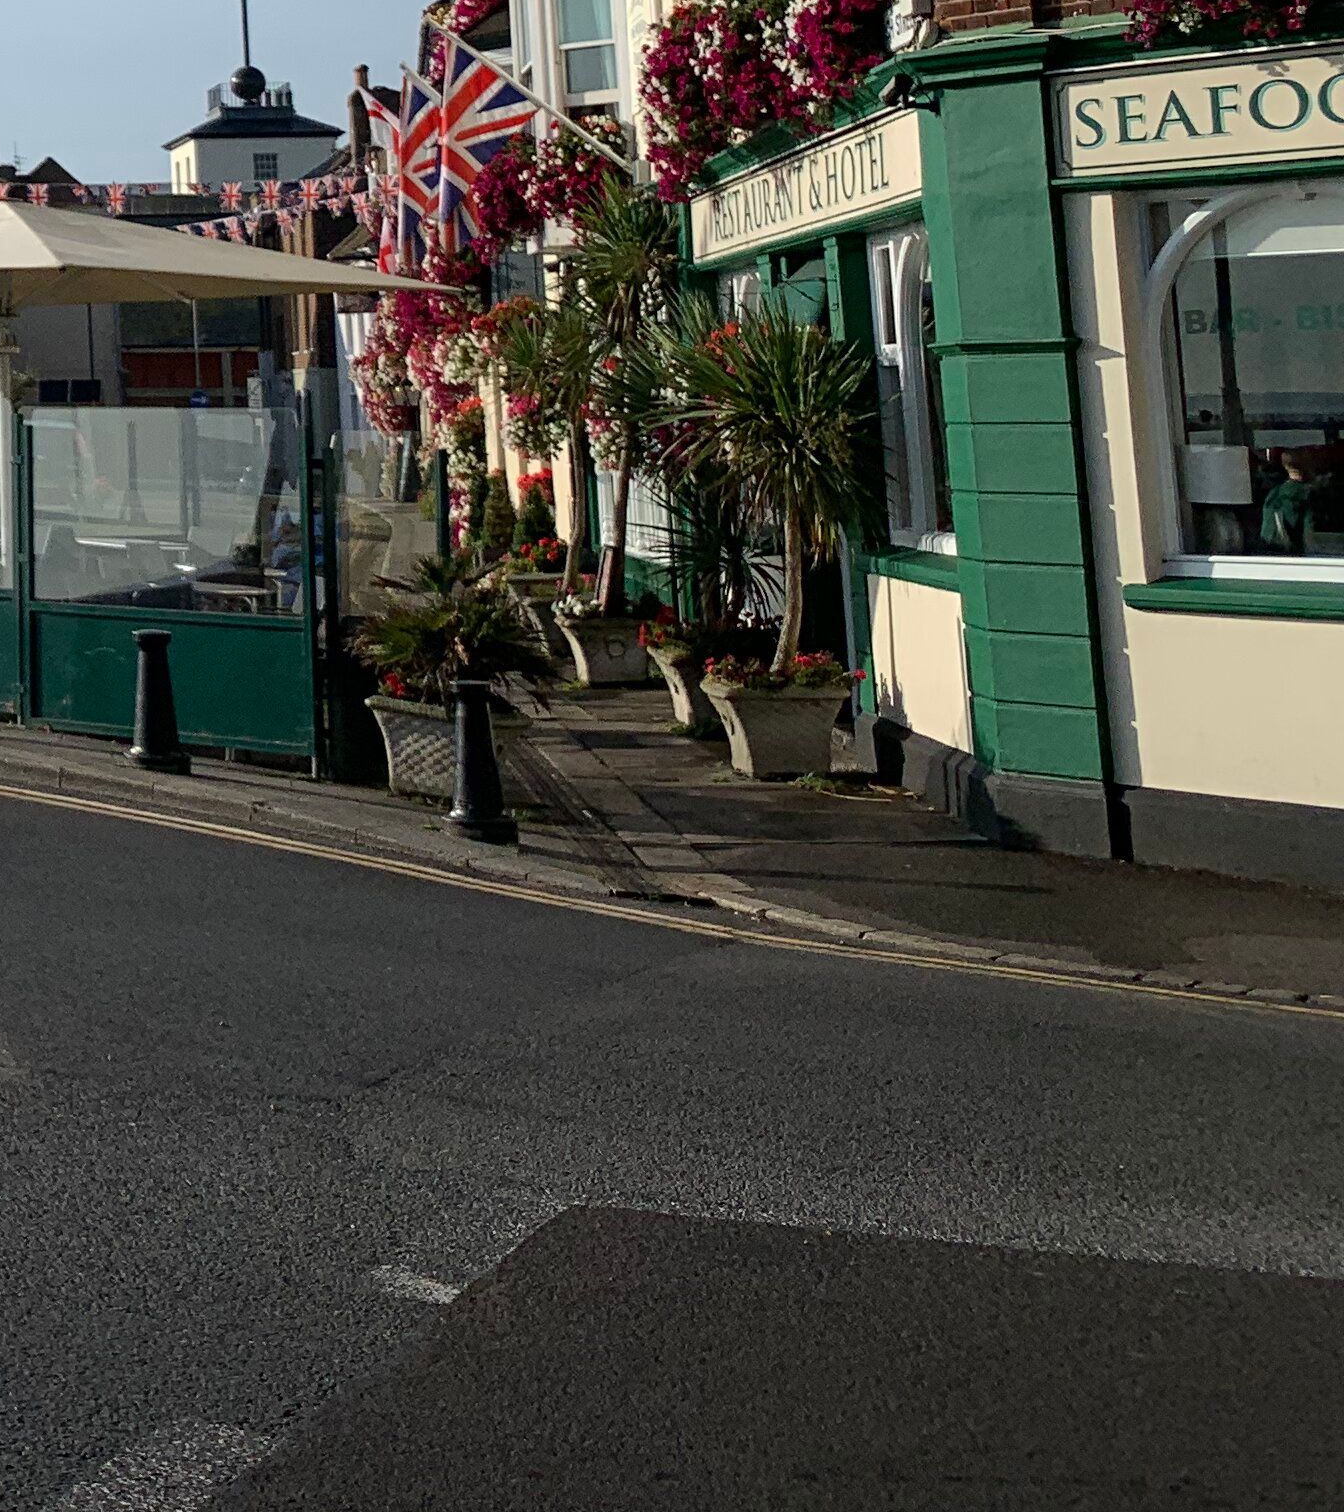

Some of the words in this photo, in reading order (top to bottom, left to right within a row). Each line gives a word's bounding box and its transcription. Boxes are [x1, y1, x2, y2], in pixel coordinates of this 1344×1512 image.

[713, 164, 804, 241] RESTAURANT
[809, 157, 823, 213] &
[824, 133, 889, 207] HOTEL
